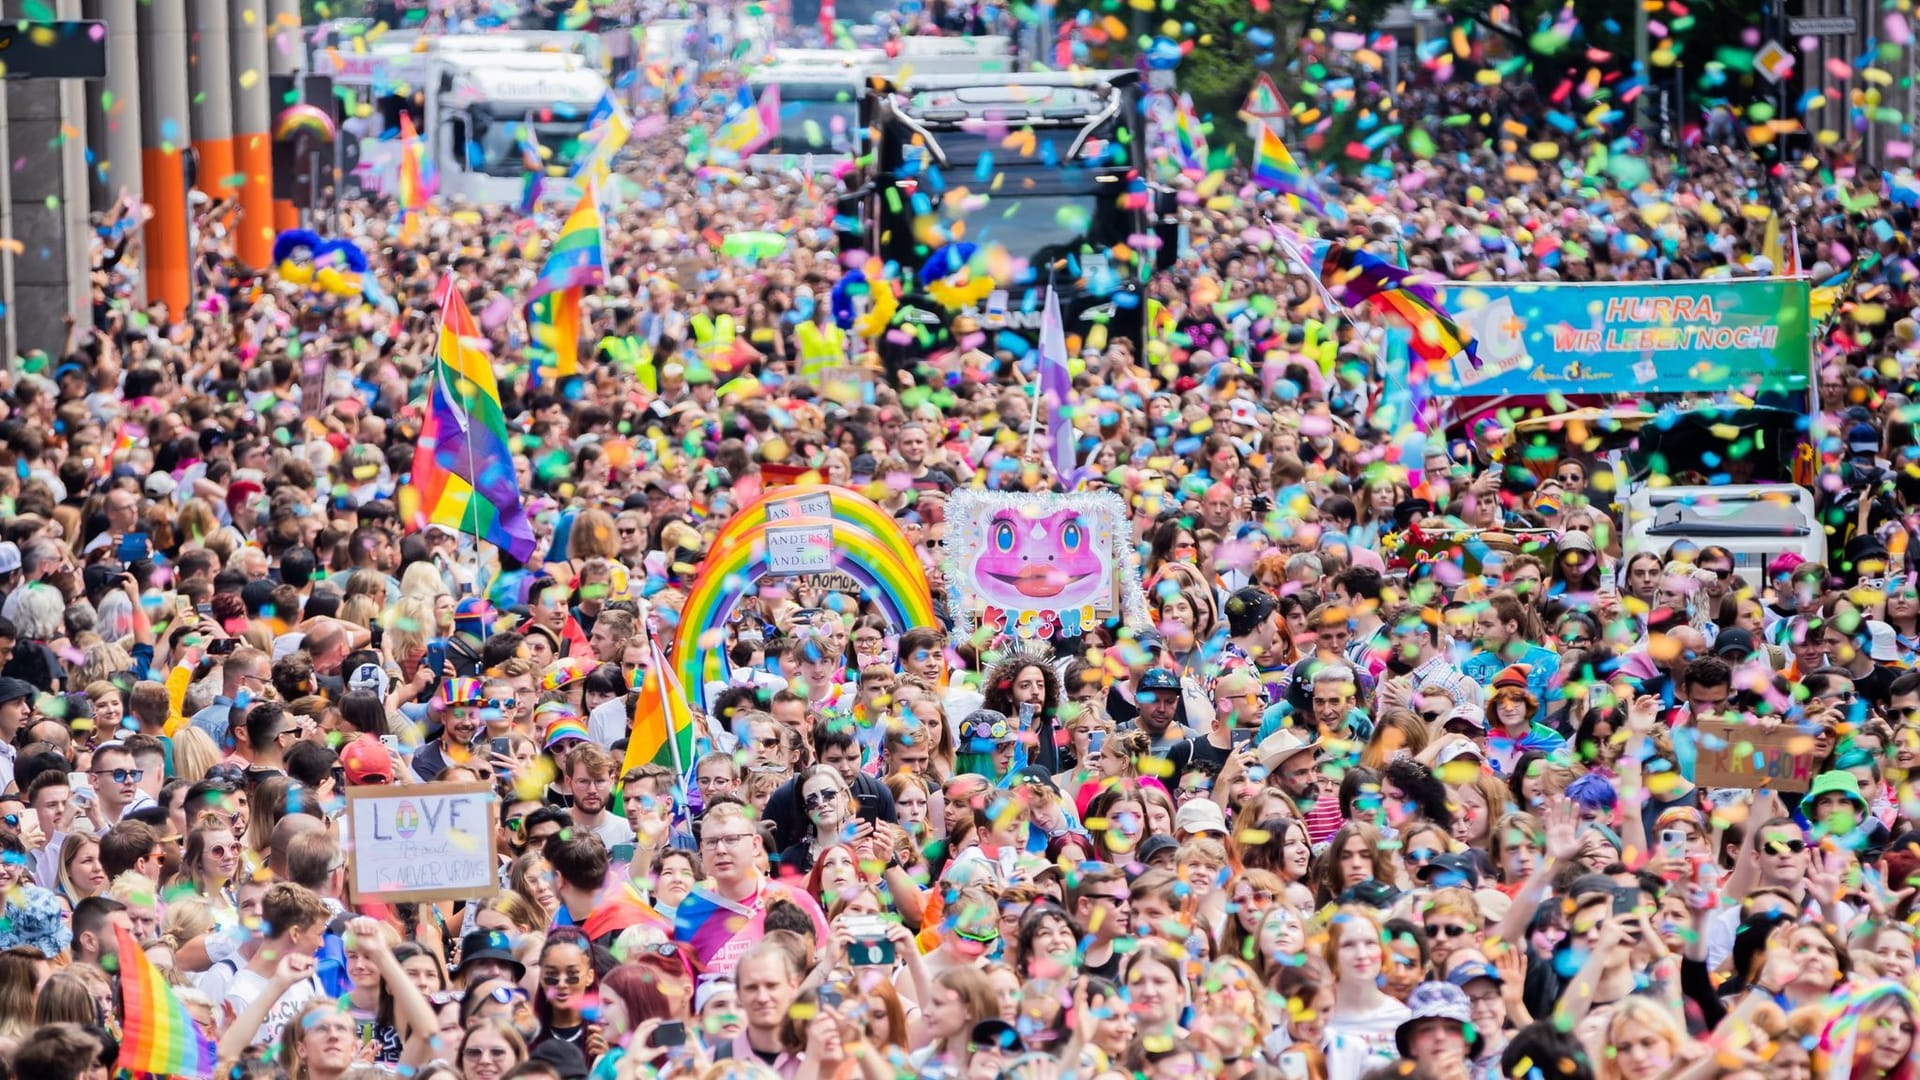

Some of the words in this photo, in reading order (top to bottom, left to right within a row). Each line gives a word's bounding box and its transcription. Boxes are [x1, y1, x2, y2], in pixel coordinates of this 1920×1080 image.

[1605, 295, 1722, 324] HURRA,
[1553, 328, 1602, 352] WIR
[1605, 328, 1692, 351] LEBEN
[1695, 325, 1779, 350] NOCH!
[772, 501, 829, 519] ANERS?
[770, 532, 829, 546] ANDERS?
[772, 554, 829, 567] ANDERS!
[982, 605, 1057, 640] KISS
[1714, 748, 1813, 781] RAIBOW
[373, 797, 472, 840] LOVE
[397, 860, 442, 887] NEVER
